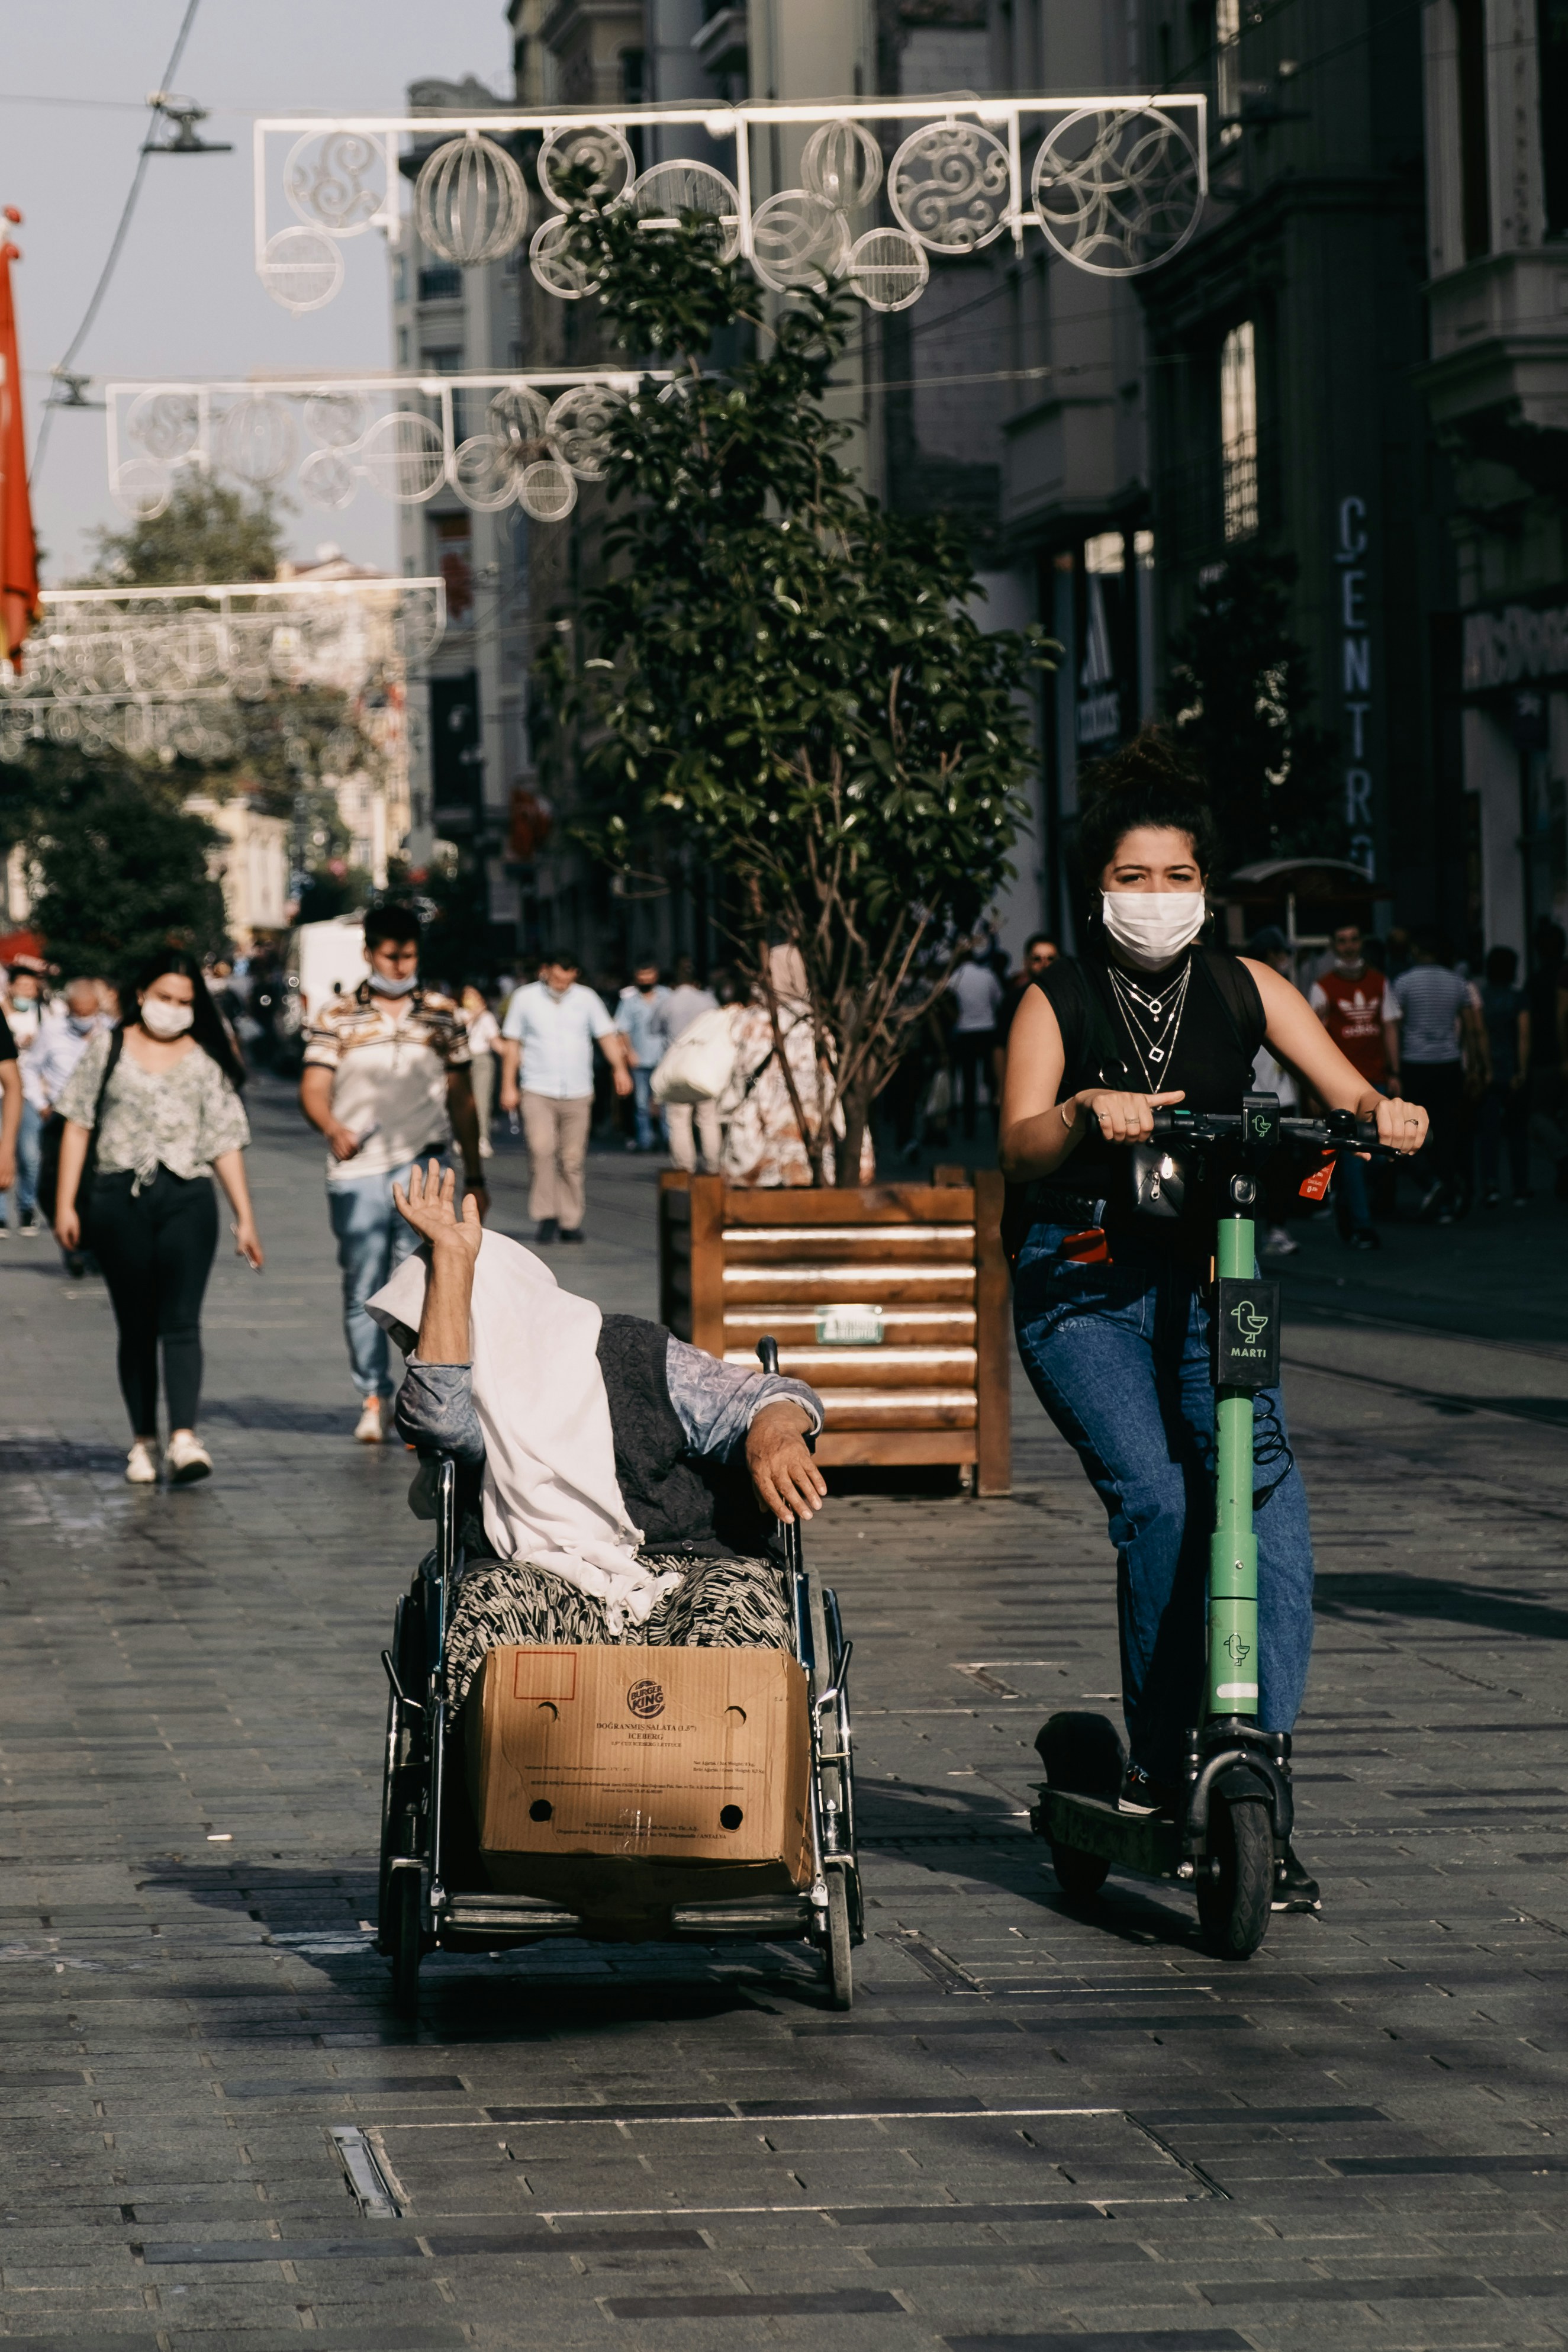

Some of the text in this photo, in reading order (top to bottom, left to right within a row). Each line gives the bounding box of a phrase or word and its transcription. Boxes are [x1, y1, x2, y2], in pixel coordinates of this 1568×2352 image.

[1231, 1347, 1267, 1358] MARTI
[631, 1685, 662, 1700] BURGER
[632, 1691, 664, 1711] KING
